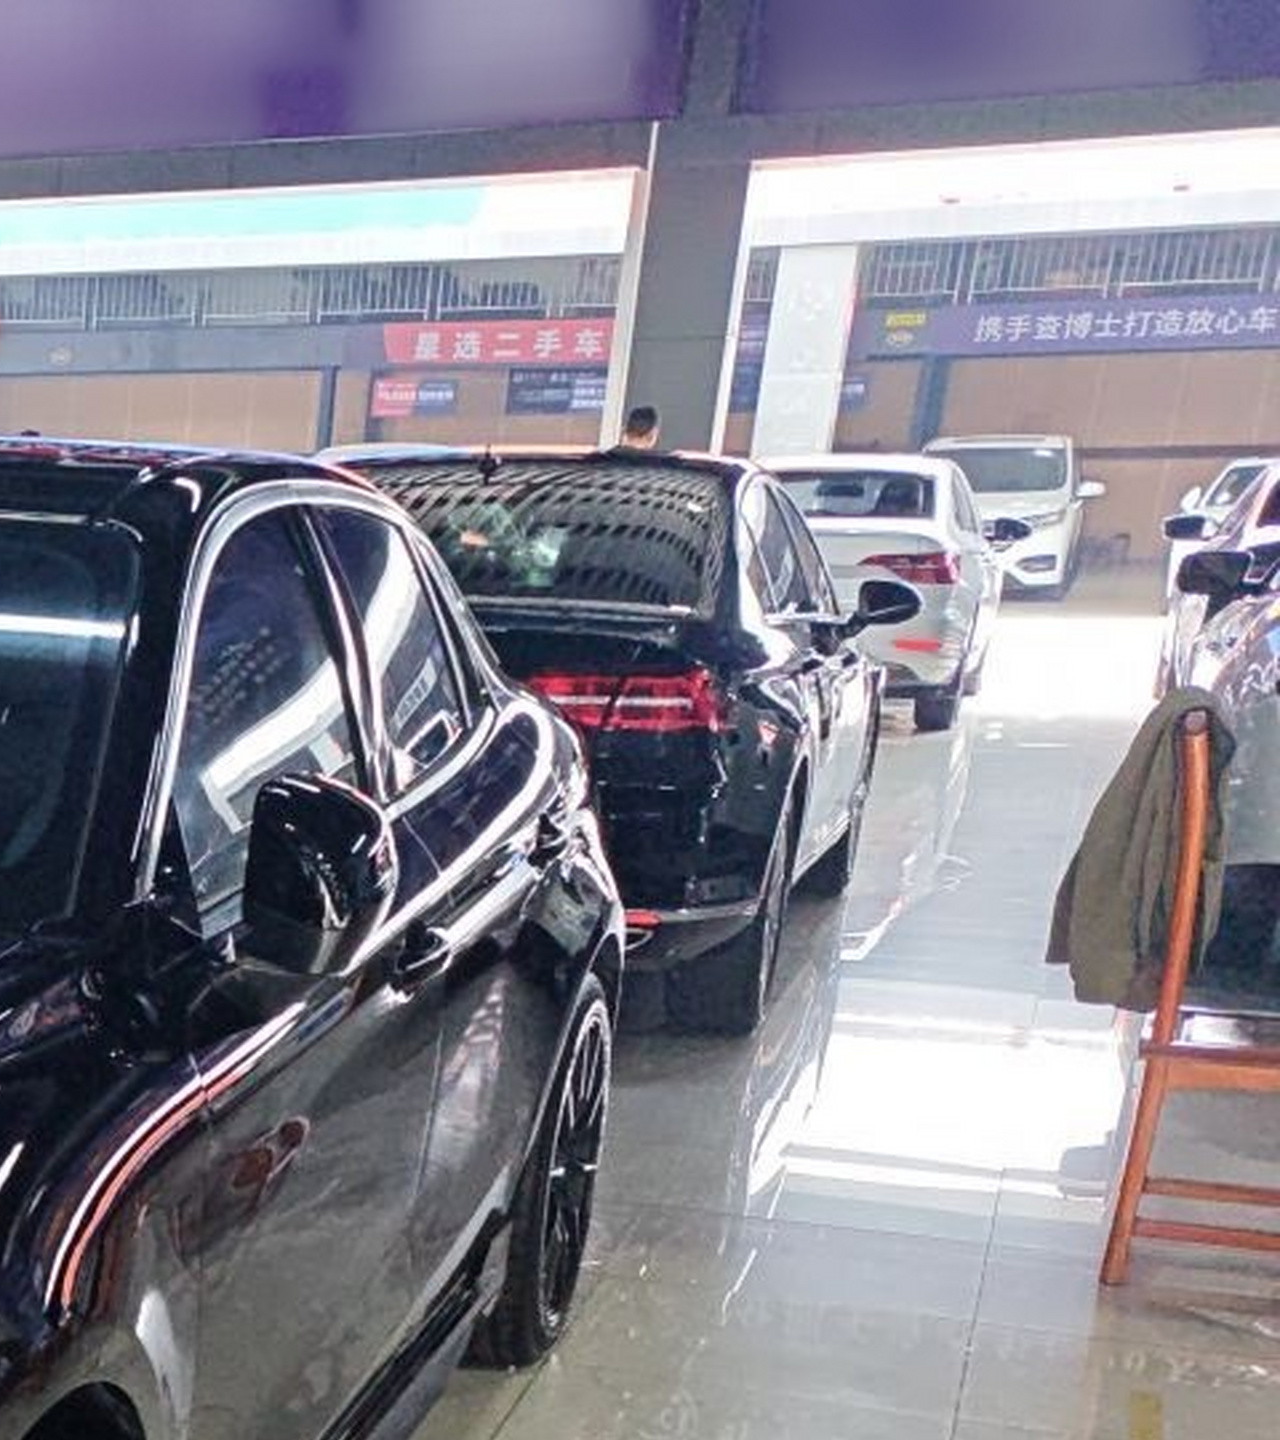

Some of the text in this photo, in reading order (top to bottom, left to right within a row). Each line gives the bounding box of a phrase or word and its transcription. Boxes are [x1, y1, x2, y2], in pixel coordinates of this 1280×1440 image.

[973, 305, 1280, 343] 携手查博士打造放心车
